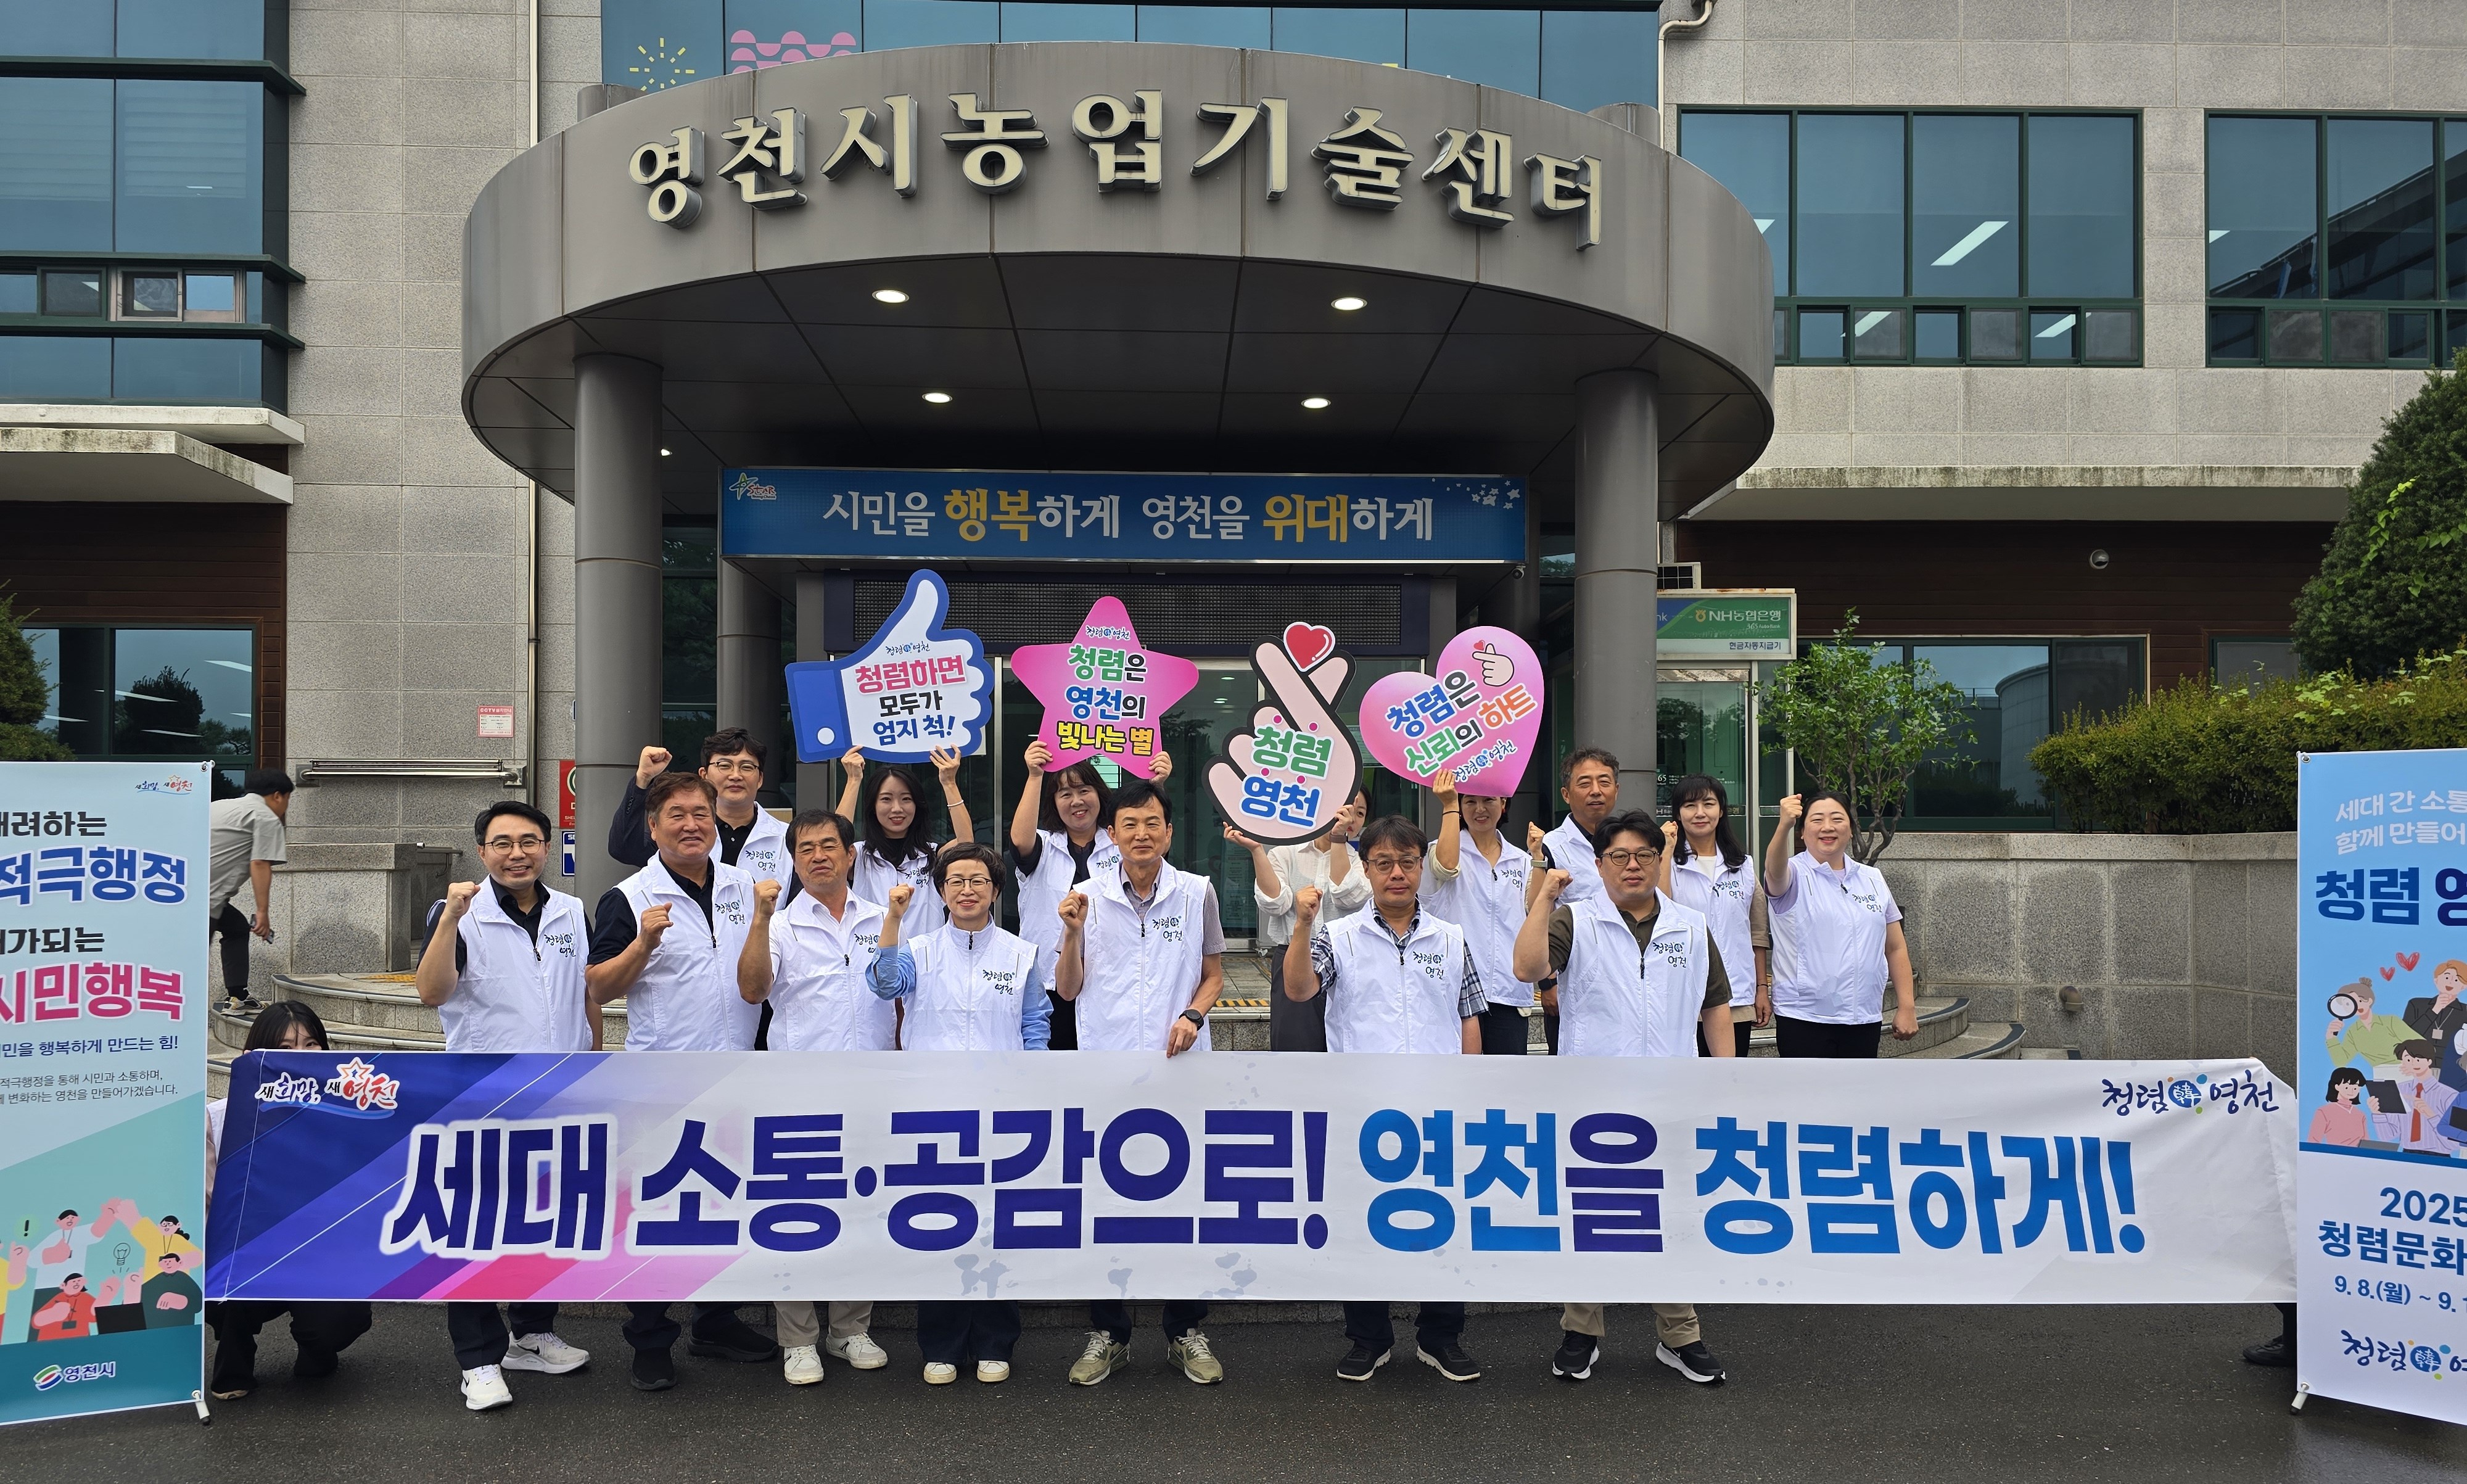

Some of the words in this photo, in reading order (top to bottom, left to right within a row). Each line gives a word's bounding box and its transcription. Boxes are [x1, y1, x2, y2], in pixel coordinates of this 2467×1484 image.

[628, 89, 1604, 251] 영천시농업기술센터
[823, 492, 936, 538] 시민을
[944, 488, 1121, 542] 행복하게
[1142, 494, 1250, 541] 영천을
[1262, 493, 1434, 543] 위대하게
[1709, 610, 1781, 622] NH농협은행
[1068, 644, 1148, 682] 청렴은
[1729, 641, 1781, 650] 현금자동지급기
[855, 654, 966, 693] 청렴하면
[879, 691, 943, 717] 모두가
[1065, 686, 1145, 720] 영천의
[1386, 670, 1481, 738] 청렴은
[873, 719, 918, 746] 엄지
[923, 714, 955, 739] 척!
[1056, 721, 1127, 754] 빛나는
[1130, 727, 1154, 756] 별
[1405, 719, 1483, 777] 신뢰의
[1478, 683, 1538, 730] 하트
[1253, 725, 1333, 779] 청렴
[1657, 774, 1666, 782] 65
[1241, 775, 1321, 828] 영천
[2335, 793, 2384, 822] 세대
[2389, 790, 2416, 813] 간
[2335, 825, 2384, 855] 함께
[0, 846, 185, 905] 적극행정
[2315, 867, 2420, 925] 청렴
[0, 928, 105, 955] 가되는
[0, 962, 184, 1023] 시민행복
[0, 1042, 35, 1058] 민을
[39, 1039, 103, 1055] 행복하게
[107, 1037, 154, 1053] 만드는
[159, 1036, 178, 1050] 힘!
[0, 1075, 54, 1089] 적극행정을
[57, 1074, 80, 1086] 통해
[82, 1072, 115, 1084] 시민과
[117, 1070, 163, 1082] 소통하며,
[8, 1091, 52, 1104] 변화하는
[56, 1089, 88, 1102] 영천을
[91, 1084, 178, 1099] 만들어가겠습니다.
[2210, 1069, 2280, 1115] 영천
[390, 1121, 609, 1251] 세대
[1359, 1108, 1664, 1252] 영천을
[1695, 1116, 2146, 1256] 청렴하게!
[63, 1361, 116, 1383] 영천시
